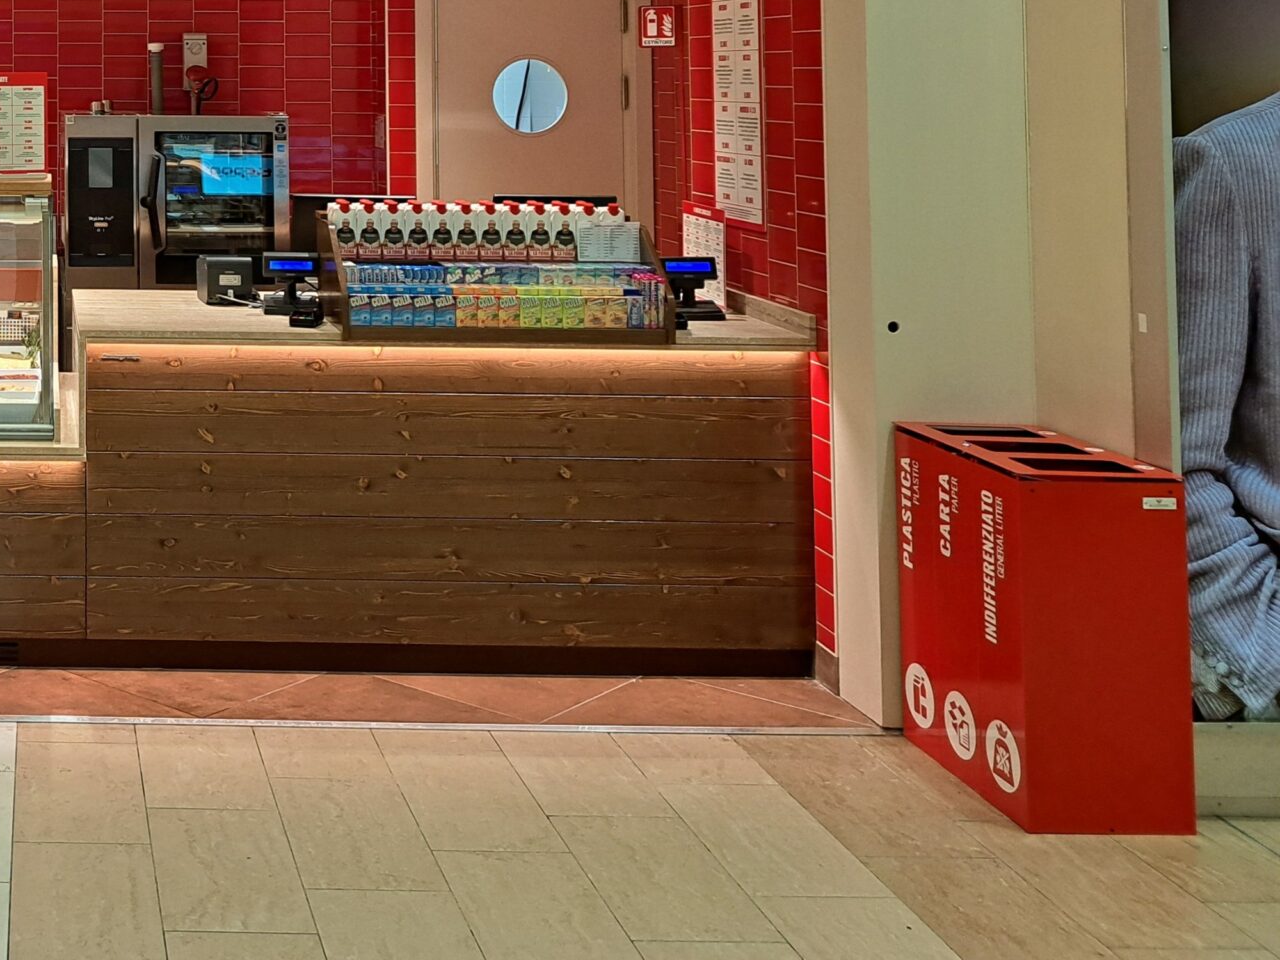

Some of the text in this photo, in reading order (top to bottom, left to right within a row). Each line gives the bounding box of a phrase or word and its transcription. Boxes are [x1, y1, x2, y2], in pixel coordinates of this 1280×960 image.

[900, 457, 914, 569] PLASTICA
[912, 460, 920, 505] PLASTIC
[938, 474, 951, 558] CARTA
[951, 476, 959, 514] PAPER
[981, 489, 997, 644] INDIFFERENZIATO
[995, 496, 1005, 579] GENERAL LITTER
